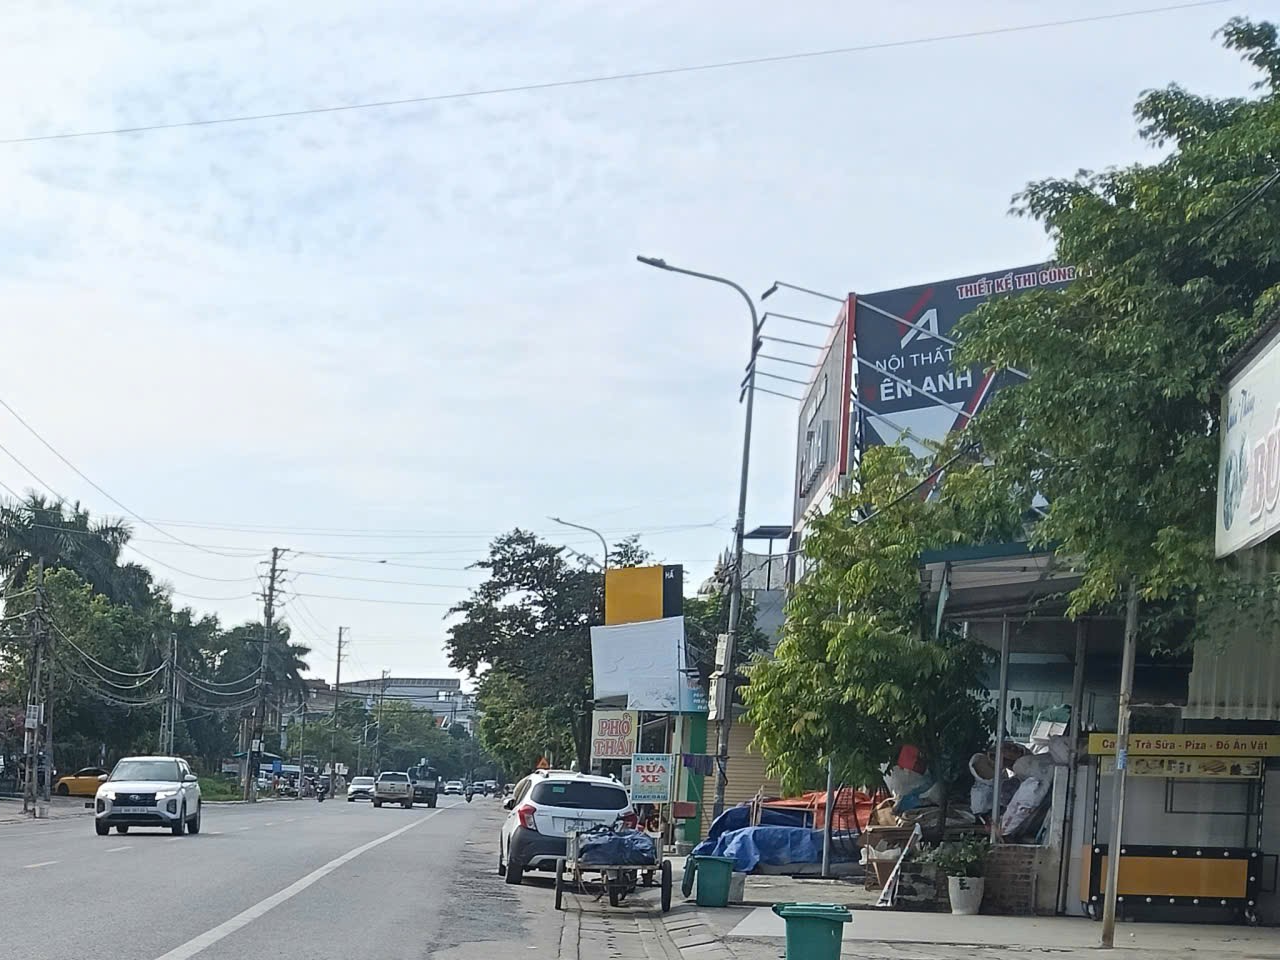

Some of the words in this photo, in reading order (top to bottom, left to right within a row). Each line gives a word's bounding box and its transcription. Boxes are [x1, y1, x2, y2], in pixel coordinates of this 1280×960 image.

[956, 277, 993, 299] THIẾT
[994, 272, 1014, 293] KẾ
[1015, 272, 1036, 289] THI
[876, 353, 905, 373] NỘI
[909, 344, 955, 367] THẤT
[921, 370, 973, 394] ANH
[599, 713, 632, 736] PHỞ
[1185, 740, 1207, 750] Piza
[640, 775, 660, 783] XE
